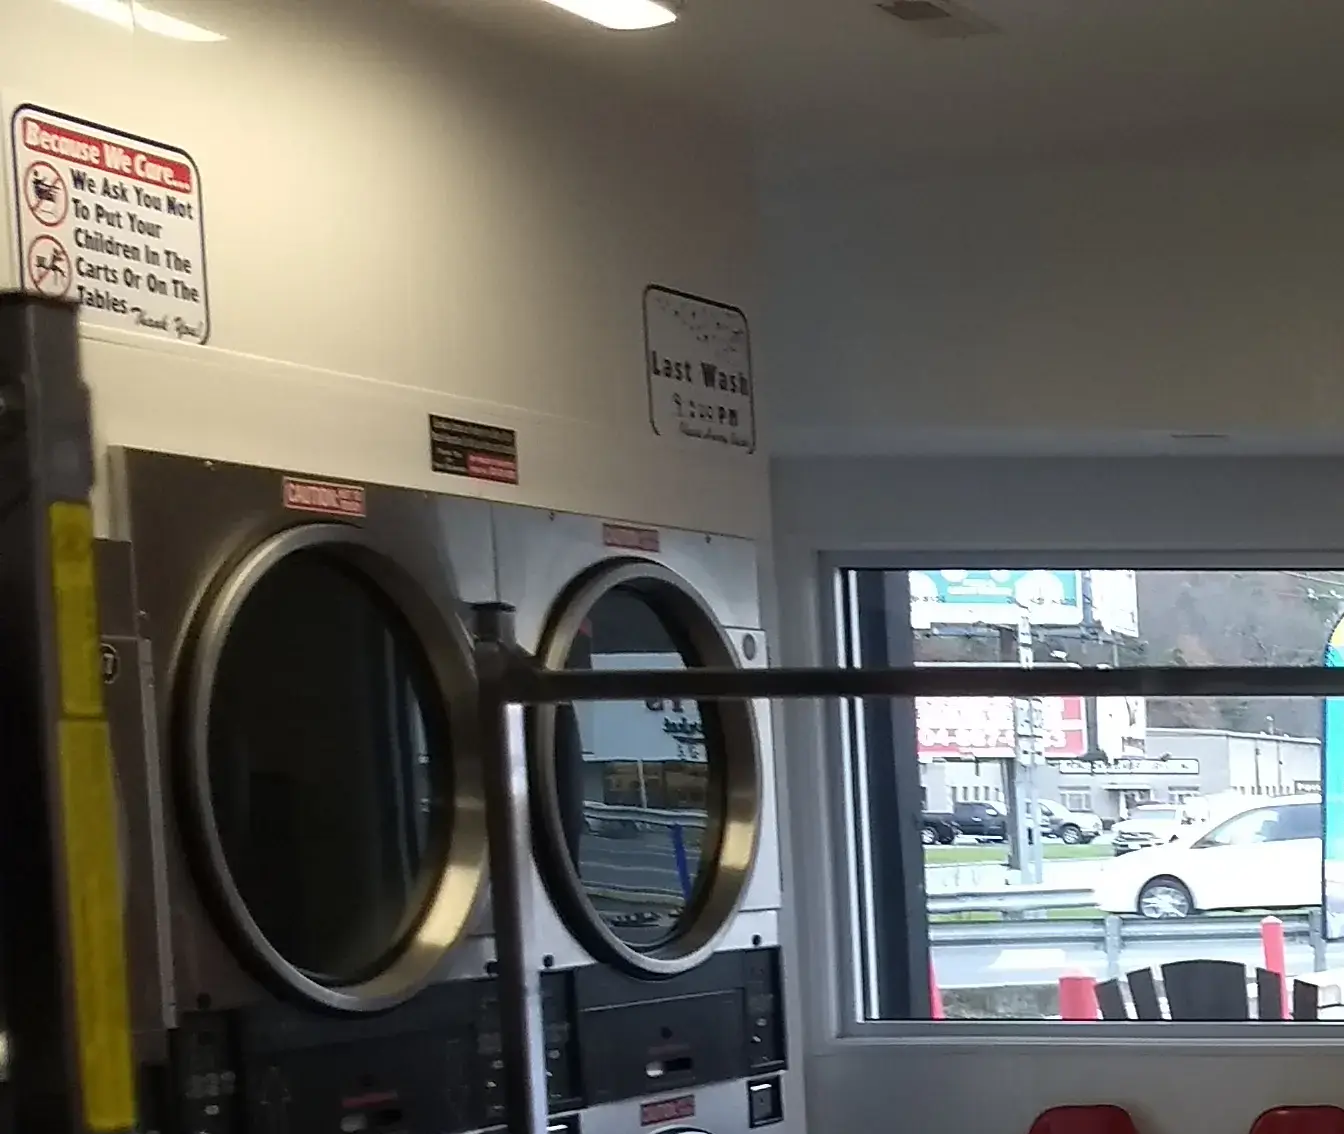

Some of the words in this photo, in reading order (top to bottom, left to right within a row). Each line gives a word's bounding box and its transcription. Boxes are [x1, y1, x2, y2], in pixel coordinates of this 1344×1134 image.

[26, 119, 100, 165] Because
[102, 143, 132, 174] We
[70, 168, 97, 194] We
[101, 177, 129, 203] Ask
[133, 185, 162, 212] You
[166, 195, 194, 221] Not
[71, 197, 91, 221] To
[95, 204, 123, 230] Put
[127, 212, 163, 239] Your
[74, 227, 141, 262] Children
[144, 244, 161, 267] In
[164, 248, 192, 274] The
[76, 256, 119, 284] Carts
[123, 267, 142, 290] Or
[147, 273, 168, 296] On
[172, 278, 200, 303] The
[77, 284, 128, 315] Tables
[652, 350, 692, 383] Last
[700, 361, 749, 396] Wash
